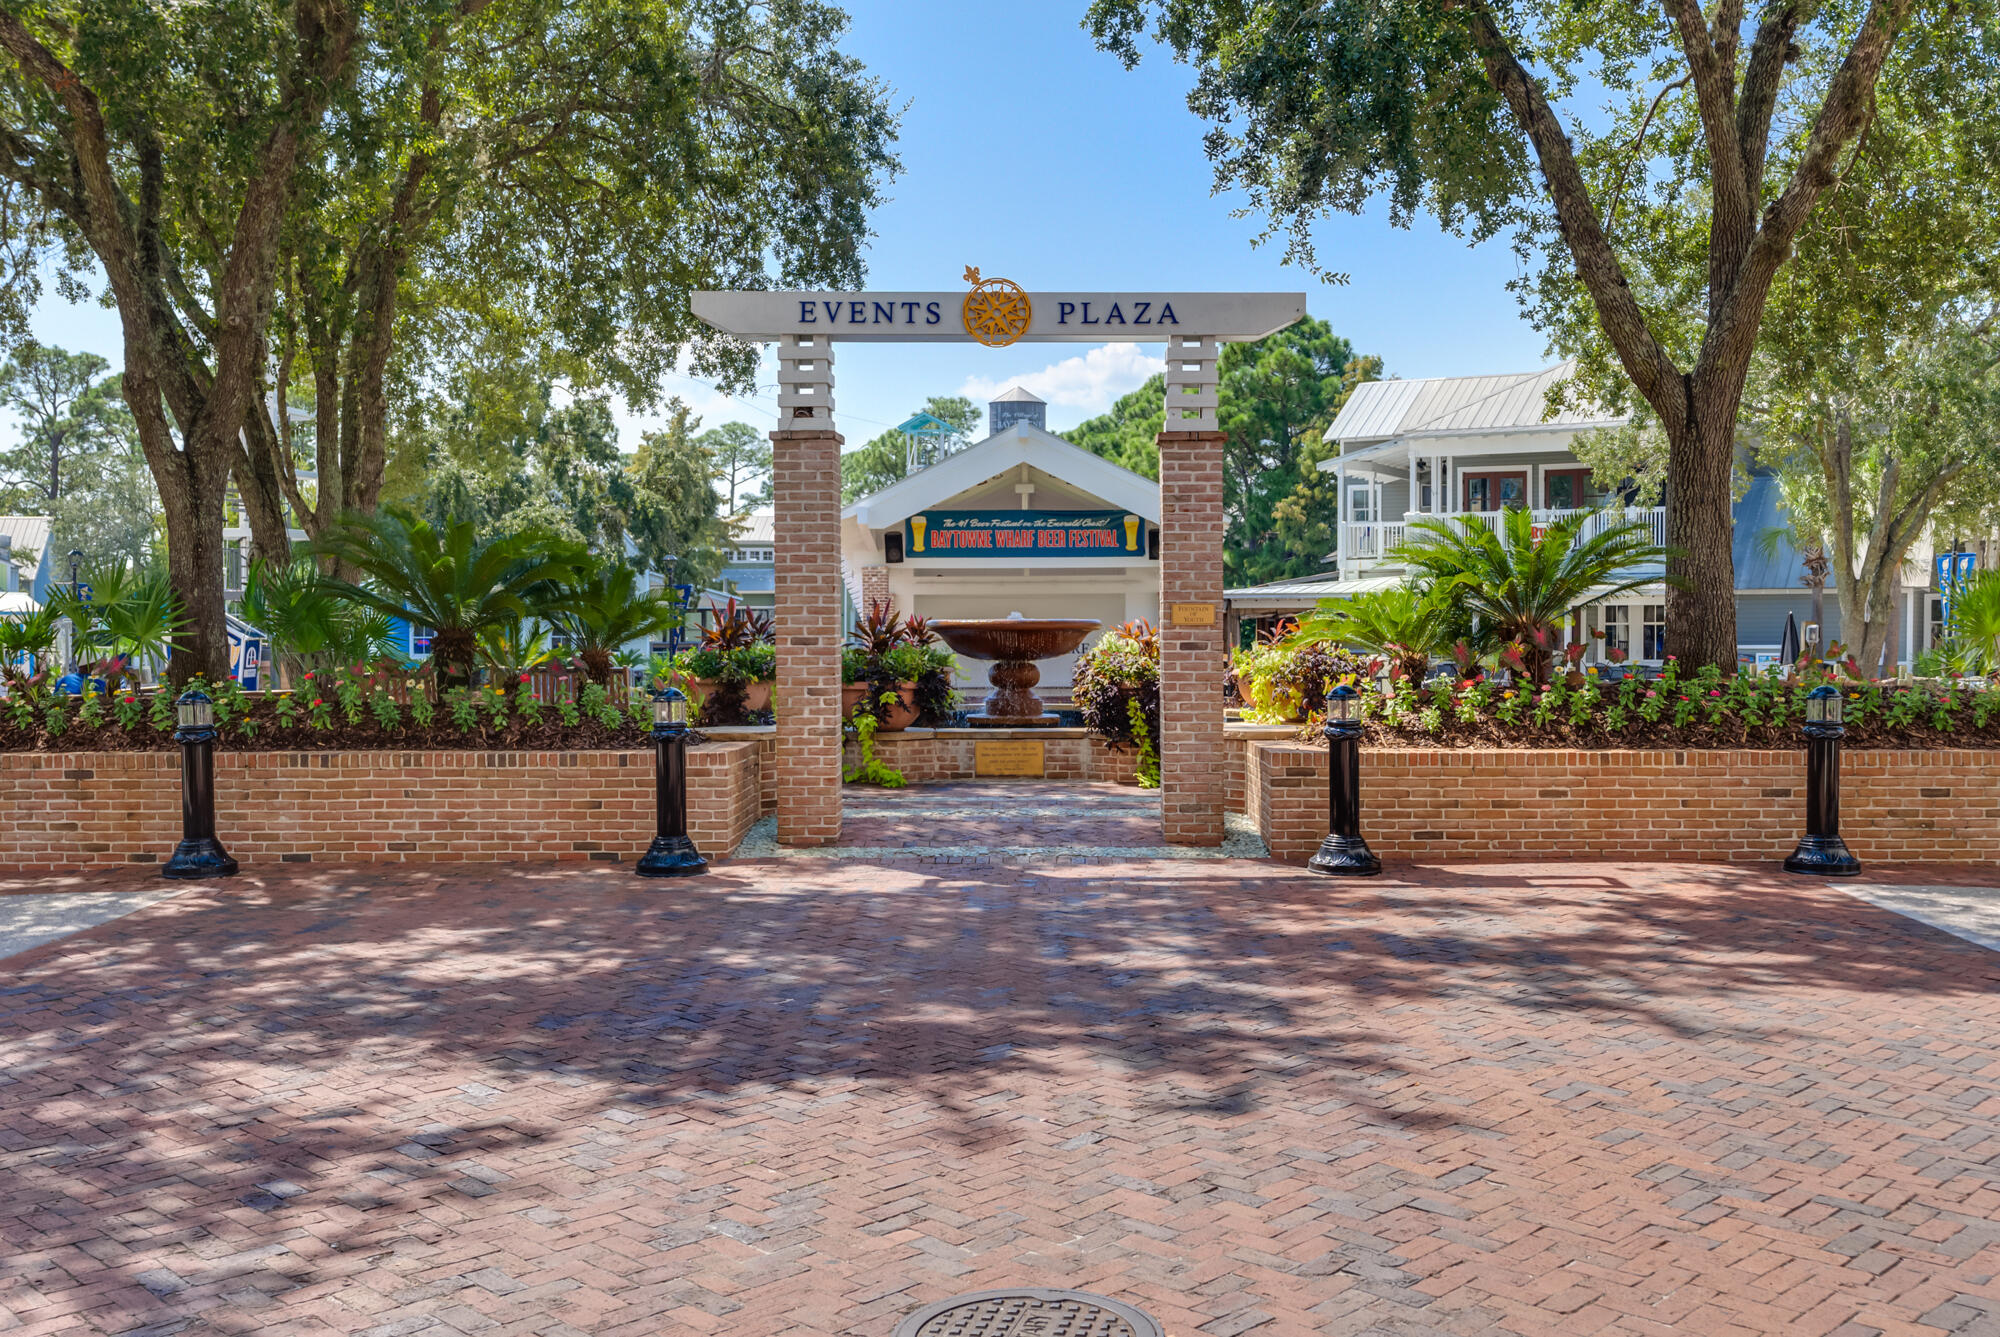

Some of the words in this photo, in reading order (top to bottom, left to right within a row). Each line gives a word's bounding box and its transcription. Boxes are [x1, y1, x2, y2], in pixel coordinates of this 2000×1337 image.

[798, 301, 941, 325] EVENTS
[1057, 301, 1180, 325] PLAZA
[943, 518, 957, 528] The
[958, 518, 969, 528] #1
[970, 518, 989, 528] Beer
[990, 518, 1024, 528] Festival
[1034, 518, 1046, 528] the
[1047, 518, 1082, 528] Emerald
[1081, 517, 1110, 527] Coast!
[931, 529, 993, 548] BAYTOWNE
[995, 529, 1035, 548] WHARF
[1037, 529, 1066, 547] BEER
[1068, 529, 1119, 547] FESTIVAL
